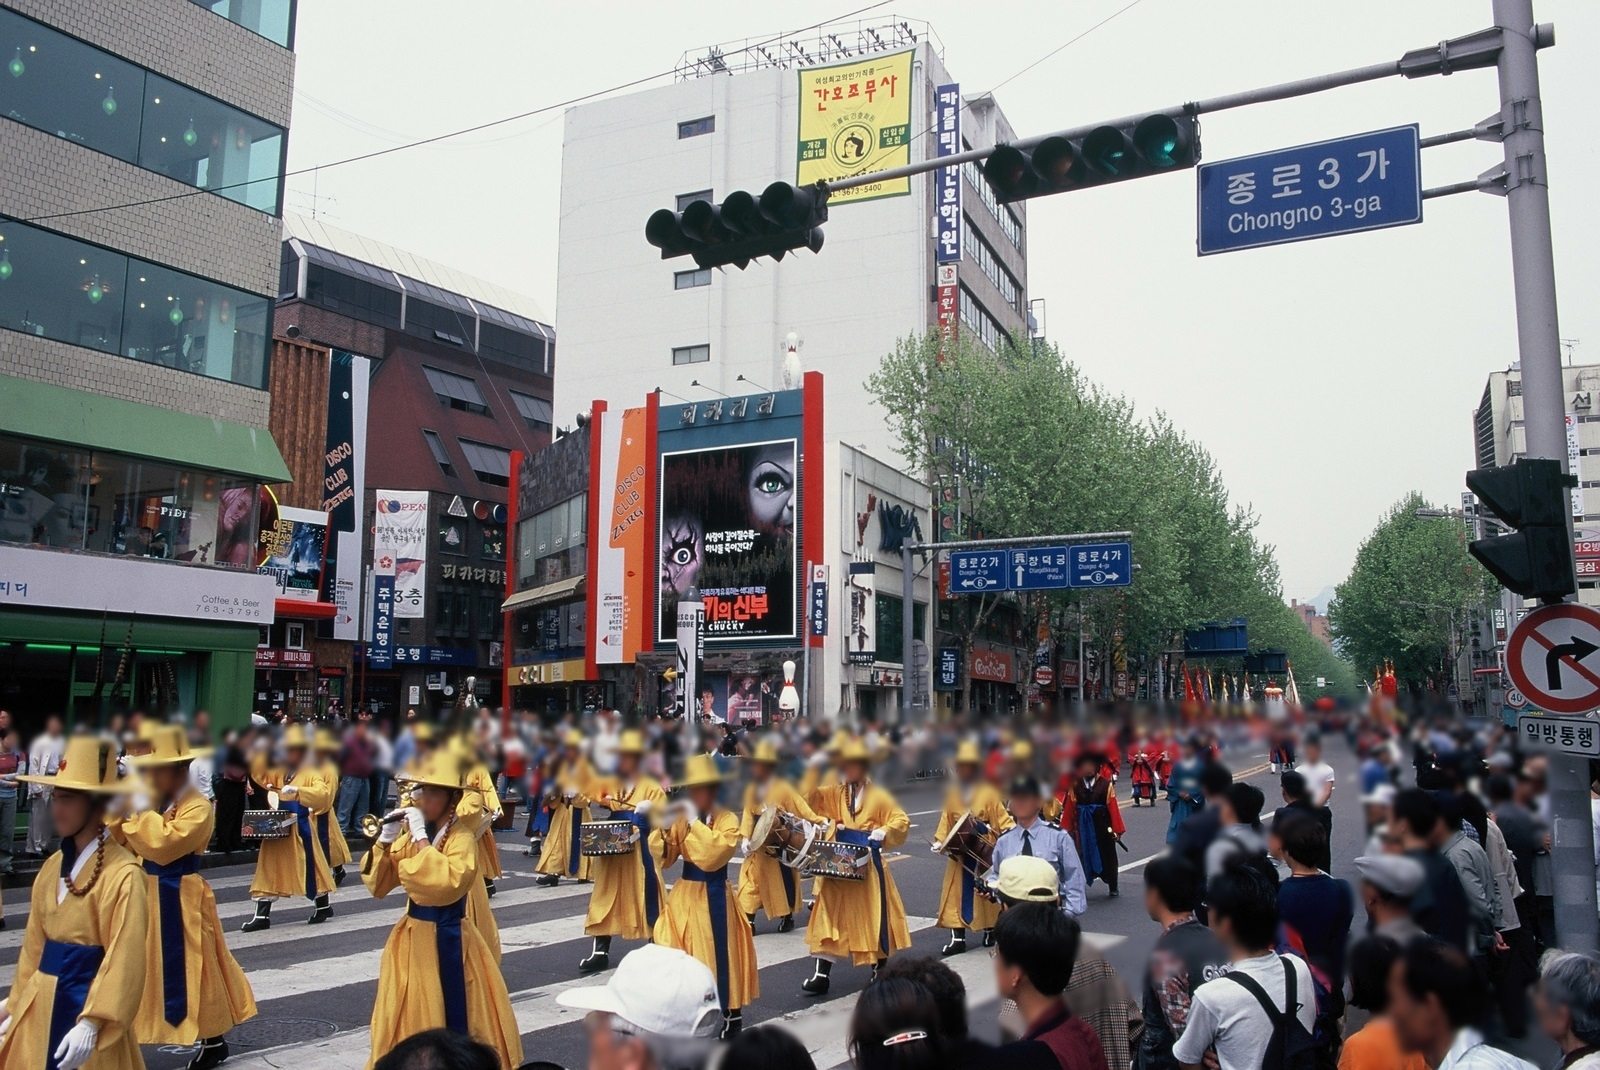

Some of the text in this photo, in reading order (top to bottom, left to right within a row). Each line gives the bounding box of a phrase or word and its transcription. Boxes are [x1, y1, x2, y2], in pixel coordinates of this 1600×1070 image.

[813, 75, 898, 112] 간호조무사
[882, 127, 906, 138] 신입생
[807, 140, 821, 149] 개강
[1228, 194, 1382, 234] Chongno 3-ga
[325, 442, 352, 468] DISCO
[325, 468, 349, 491] CLUB
[616, 465, 645, 495] DISCO
[615, 490, 640, 516] CLUB
[1574, 543, 1600, 553] 디오방
[1029, 554, 1065, 567] 창덕궁
[977, 579, 984, 587] 6
[1095, 572, 1102, 582] 6
[202, 594, 260, 607] Coffee & Beer
[394, 588, 423, 606] 3층
[376, 586, 391, 647] 주택은행
[703, 594, 769, 622] 키의 신부
[708, 622, 745, 632] CHUCKY
[942, 651, 956, 684] 노래방
[1510, 693, 1523, 703] 40
[1526, 723, 1593, 748] 일방통행
